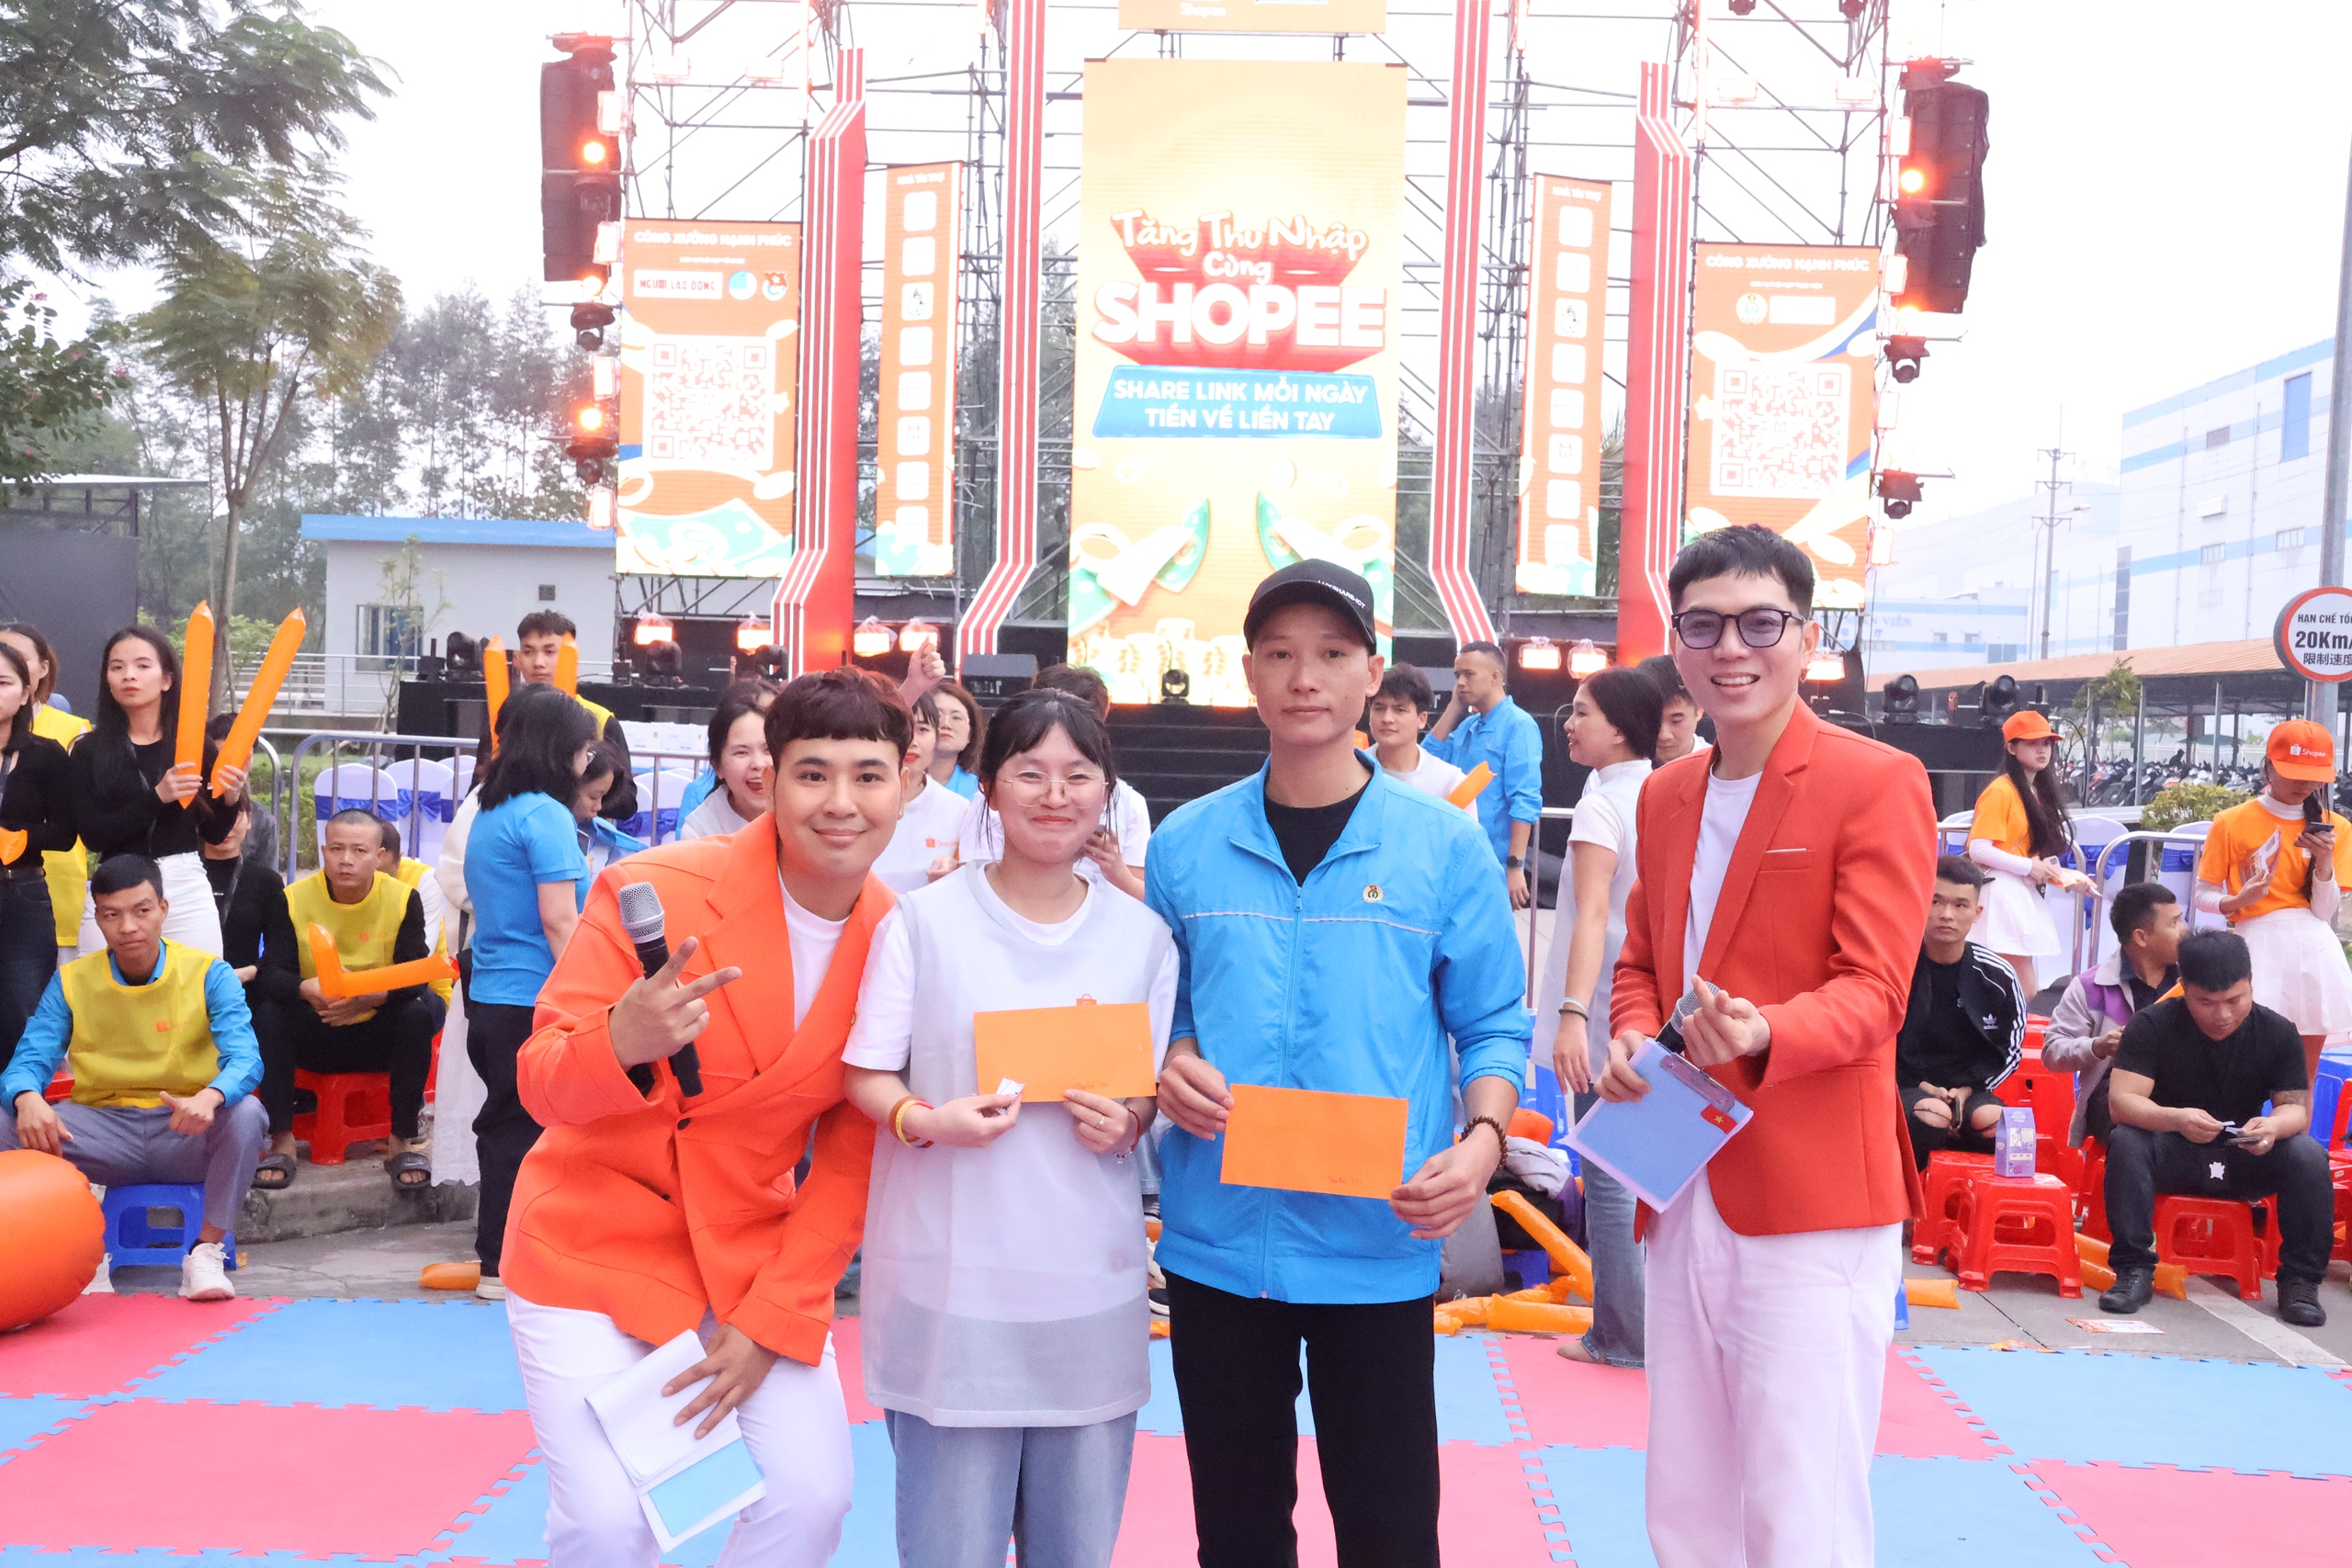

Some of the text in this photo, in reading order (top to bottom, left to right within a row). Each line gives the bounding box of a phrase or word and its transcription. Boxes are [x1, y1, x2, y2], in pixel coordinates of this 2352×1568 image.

[1180, 3, 1227, 18] Shopee
[1111, 209, 1367, 261] Tăng Thu Nhập
[1204, 251, 1272, 285] Cùng
[1093, 281, 1385, 347] SHOPEE
[1114, 375, 1368, 404] SHARE LINK MỖI NGÀY
[1145, 401, 1336, 431] TIỀN VỀ LIỀN TAY
[2298, 615, 2316, 625] HẠN
[2319, 612, 2337, 624] CHẾ
[2301, 749, 2326, 758] Shopee
